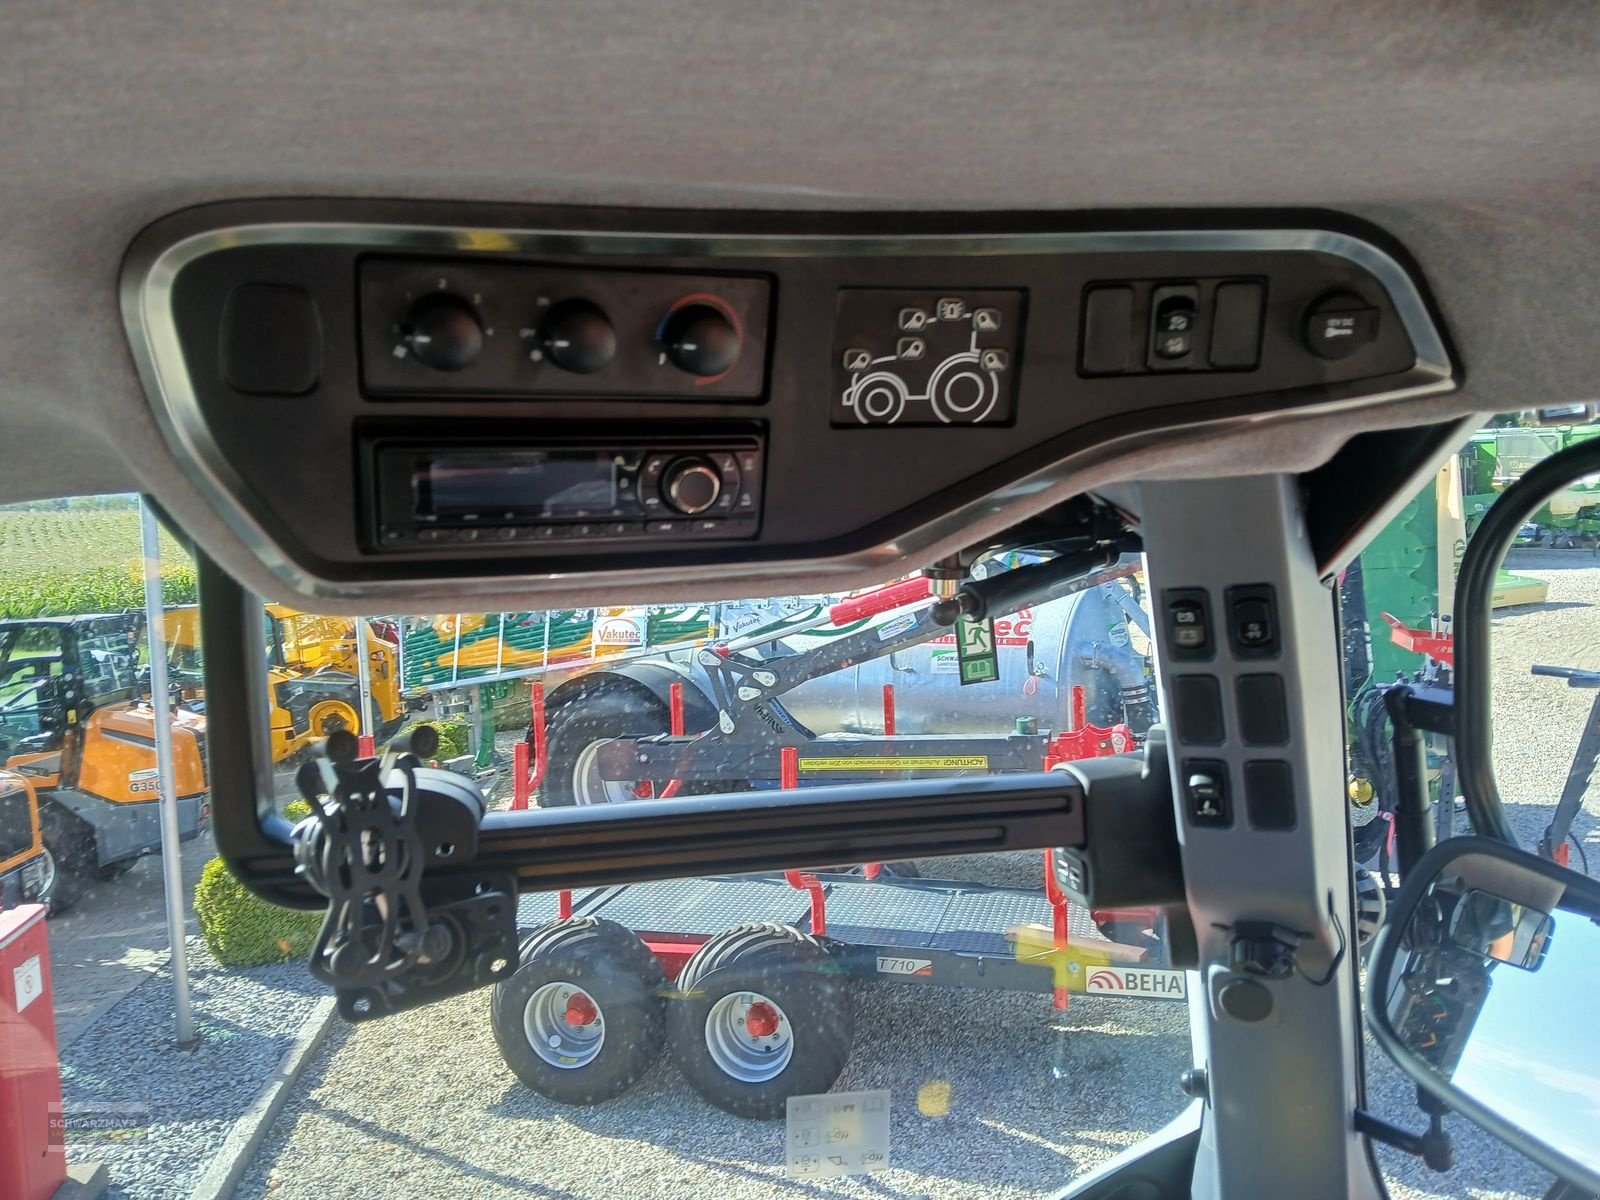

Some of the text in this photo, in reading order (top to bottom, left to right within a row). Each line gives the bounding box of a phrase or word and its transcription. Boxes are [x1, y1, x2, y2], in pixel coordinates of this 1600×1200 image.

[598, 625, 641, 643] Vakutec
[944, 758, 984, 766] ACHTUNG!
[879, 958, 915, 972] T 710
[1125, 972, 1182, 994] BEHA
